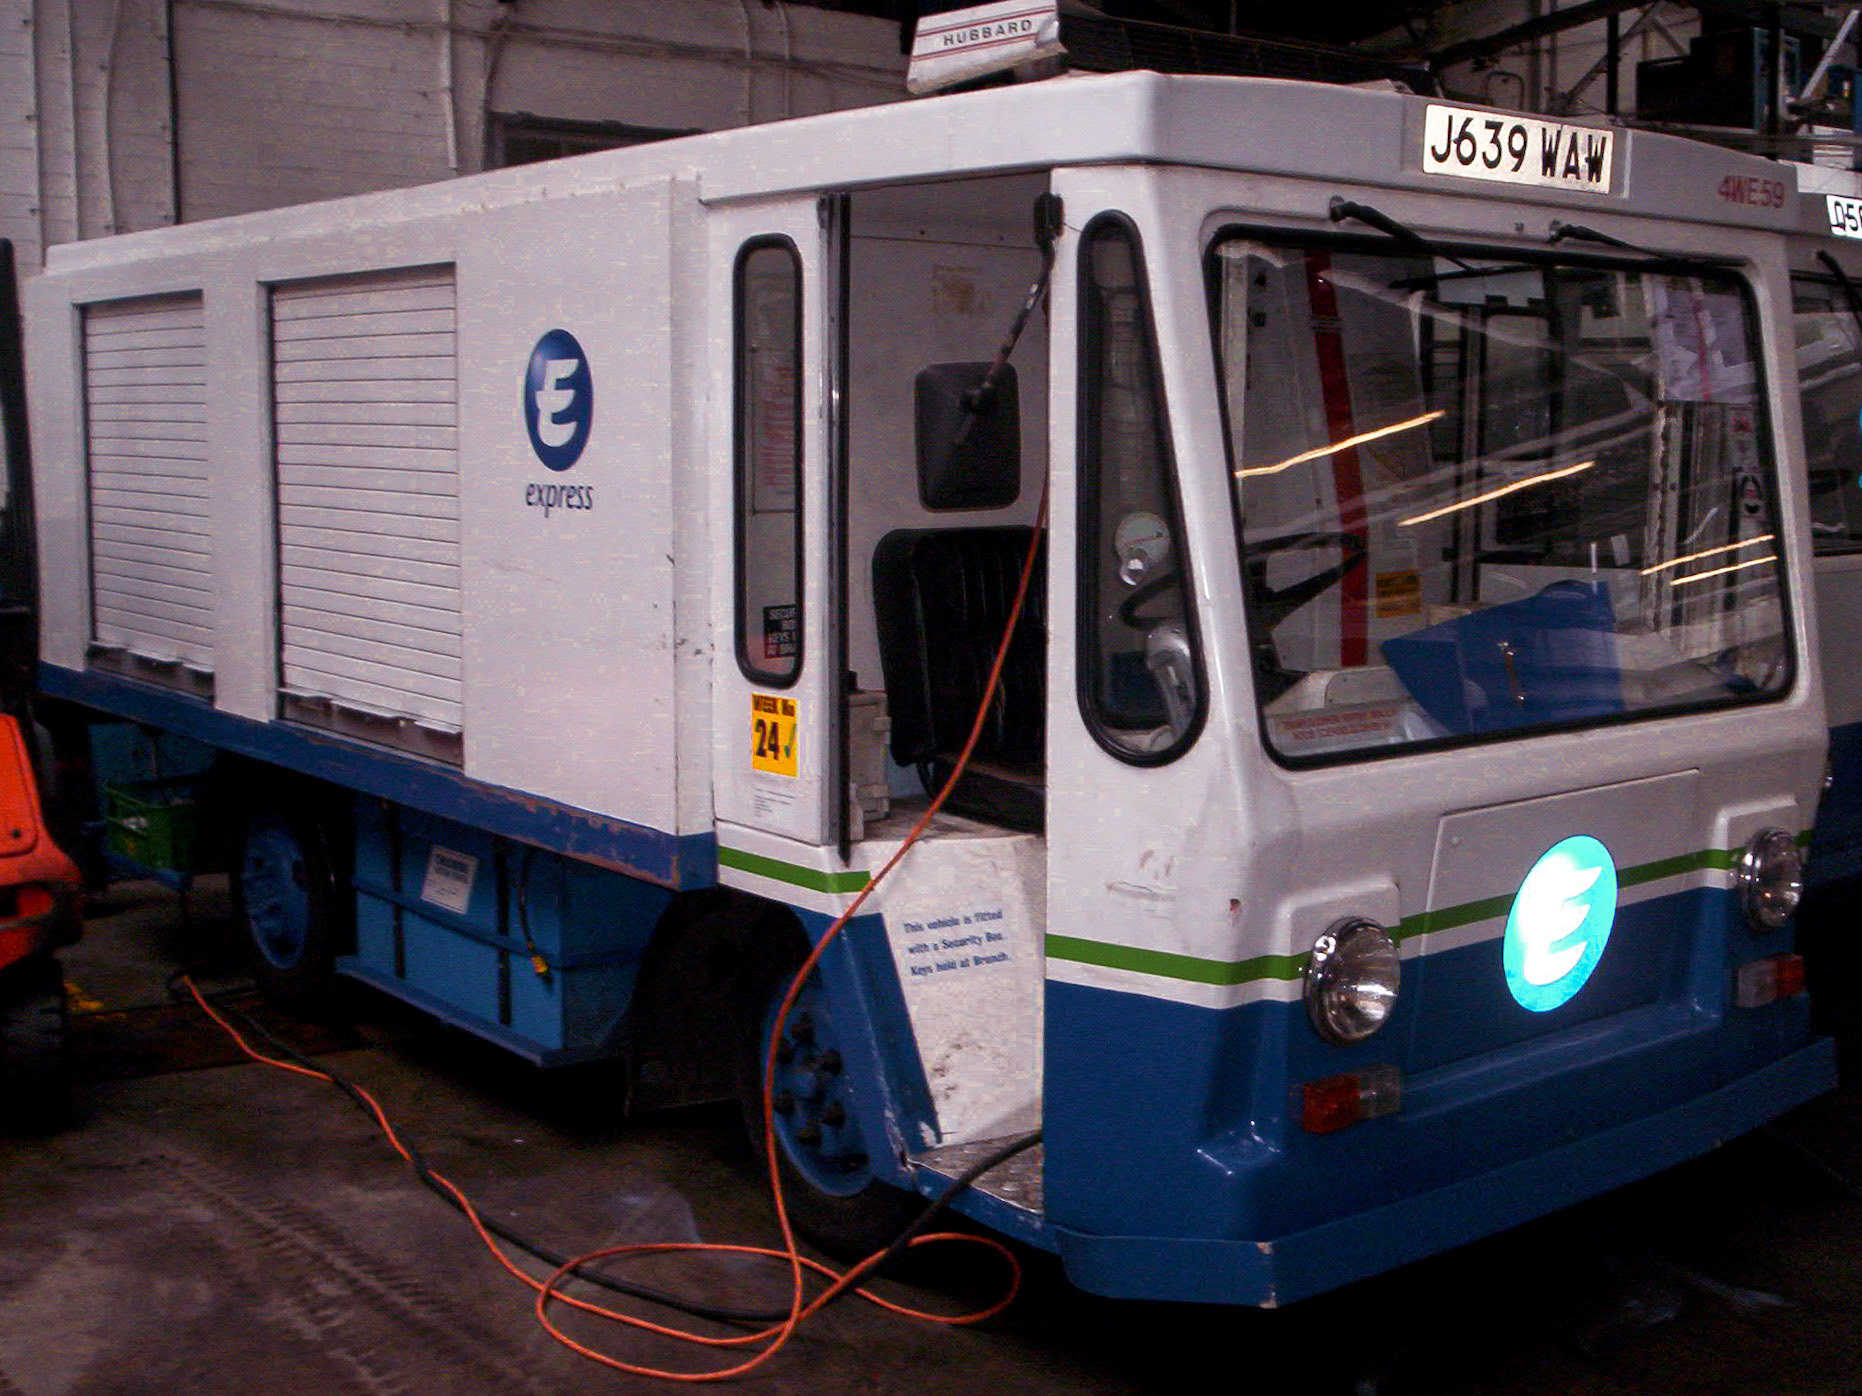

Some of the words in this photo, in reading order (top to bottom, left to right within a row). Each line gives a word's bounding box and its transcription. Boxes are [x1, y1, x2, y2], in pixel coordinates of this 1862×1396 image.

[943, 19, 1033, 46] HUBBARD
[1431, 115, 1529, 173] J639
[1541, 127, 1607, 183] WAW
[525, 483, 594, 518] express
[755, 718, 779, 760] 24
[903, 923, 924, 934] This
[927, 917, 960, 930] vehicle
[963, 915, 972, 924] is
[908, 943, 930, 954] with
[942, 935, 983, 949] Security
[911, 965, 933, 976] Keys
[936, 959, 957, 972] held
[960, 957, 970, 968] at
[973, 951, 1008, 966] Branch
